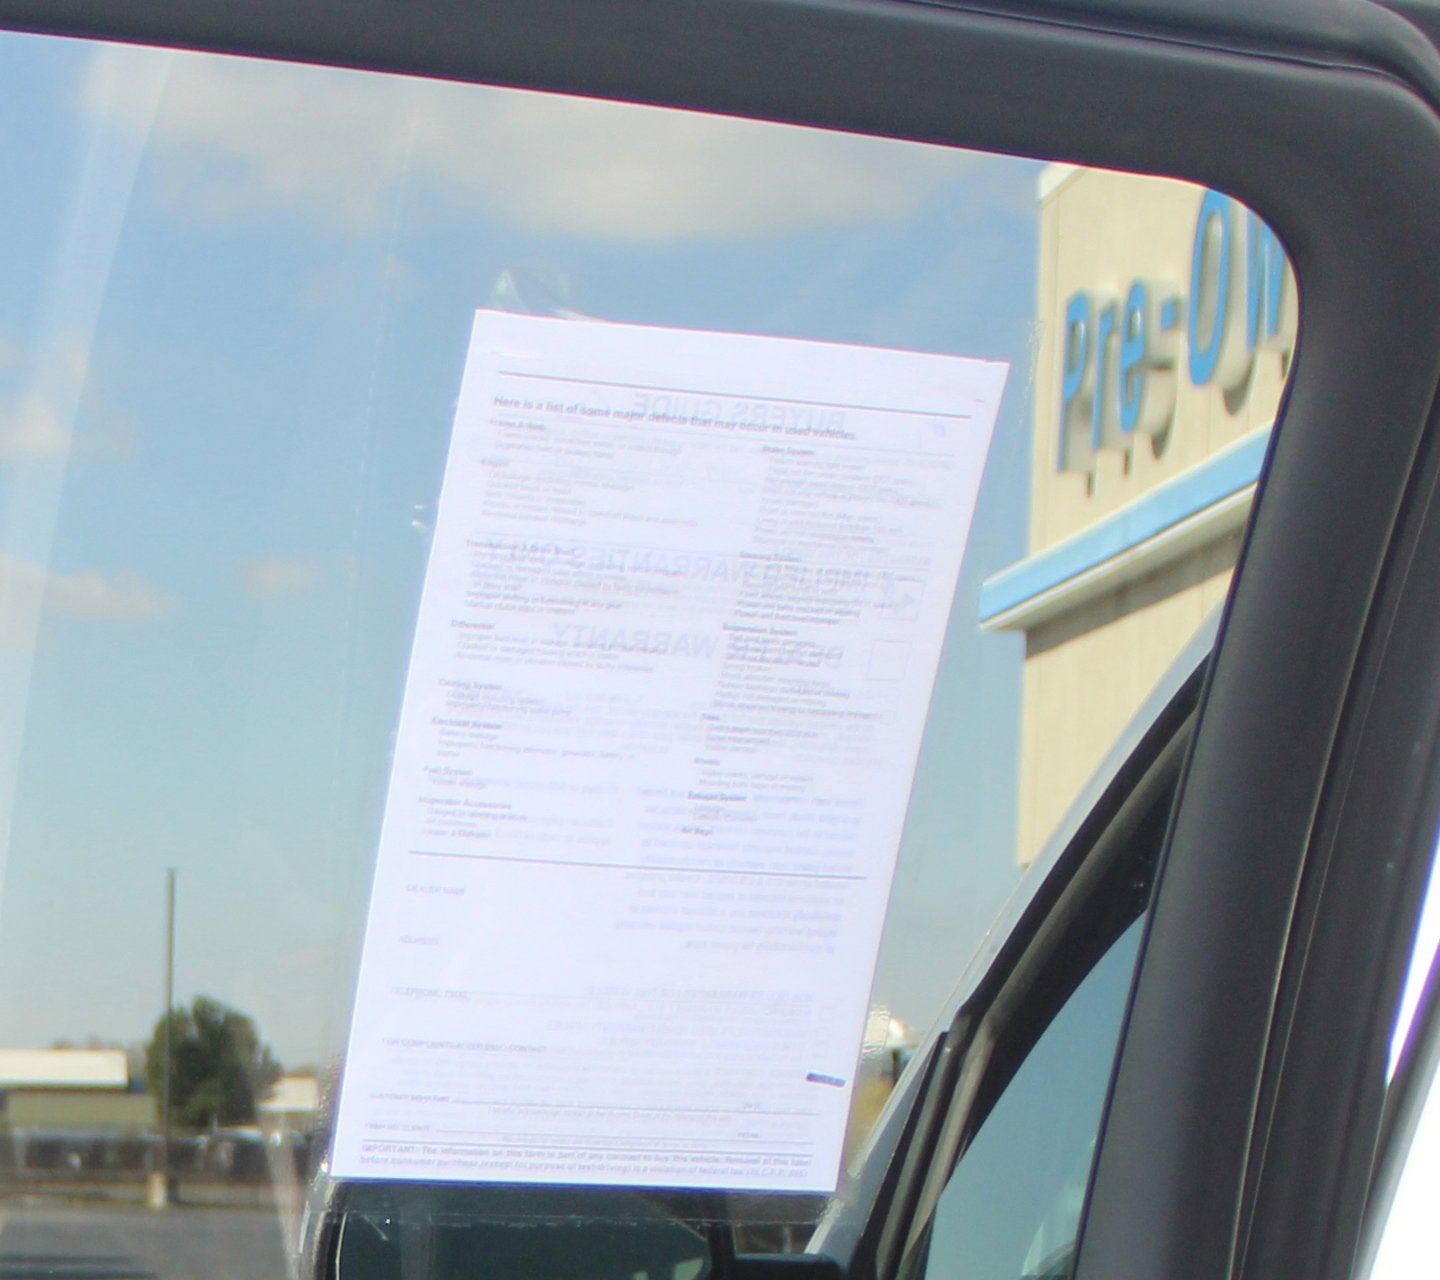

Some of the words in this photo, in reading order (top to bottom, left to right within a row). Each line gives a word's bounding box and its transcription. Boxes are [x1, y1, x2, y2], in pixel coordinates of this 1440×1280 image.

[494, 395, 520, 408] Here
[523, 398, 533, 410] is
[545, 401, 563, 412] list
[566, 403, 578, 414] of
[581, 406, 610, 417] some
[613, 409, 645, 421] major
[648, 412, 687, 424] defects
[690, 416, 711, 427] that
[714, 419, 736, 431] may
[740, 422, 770, 433] occur
[784, 425, 810, 436] used
